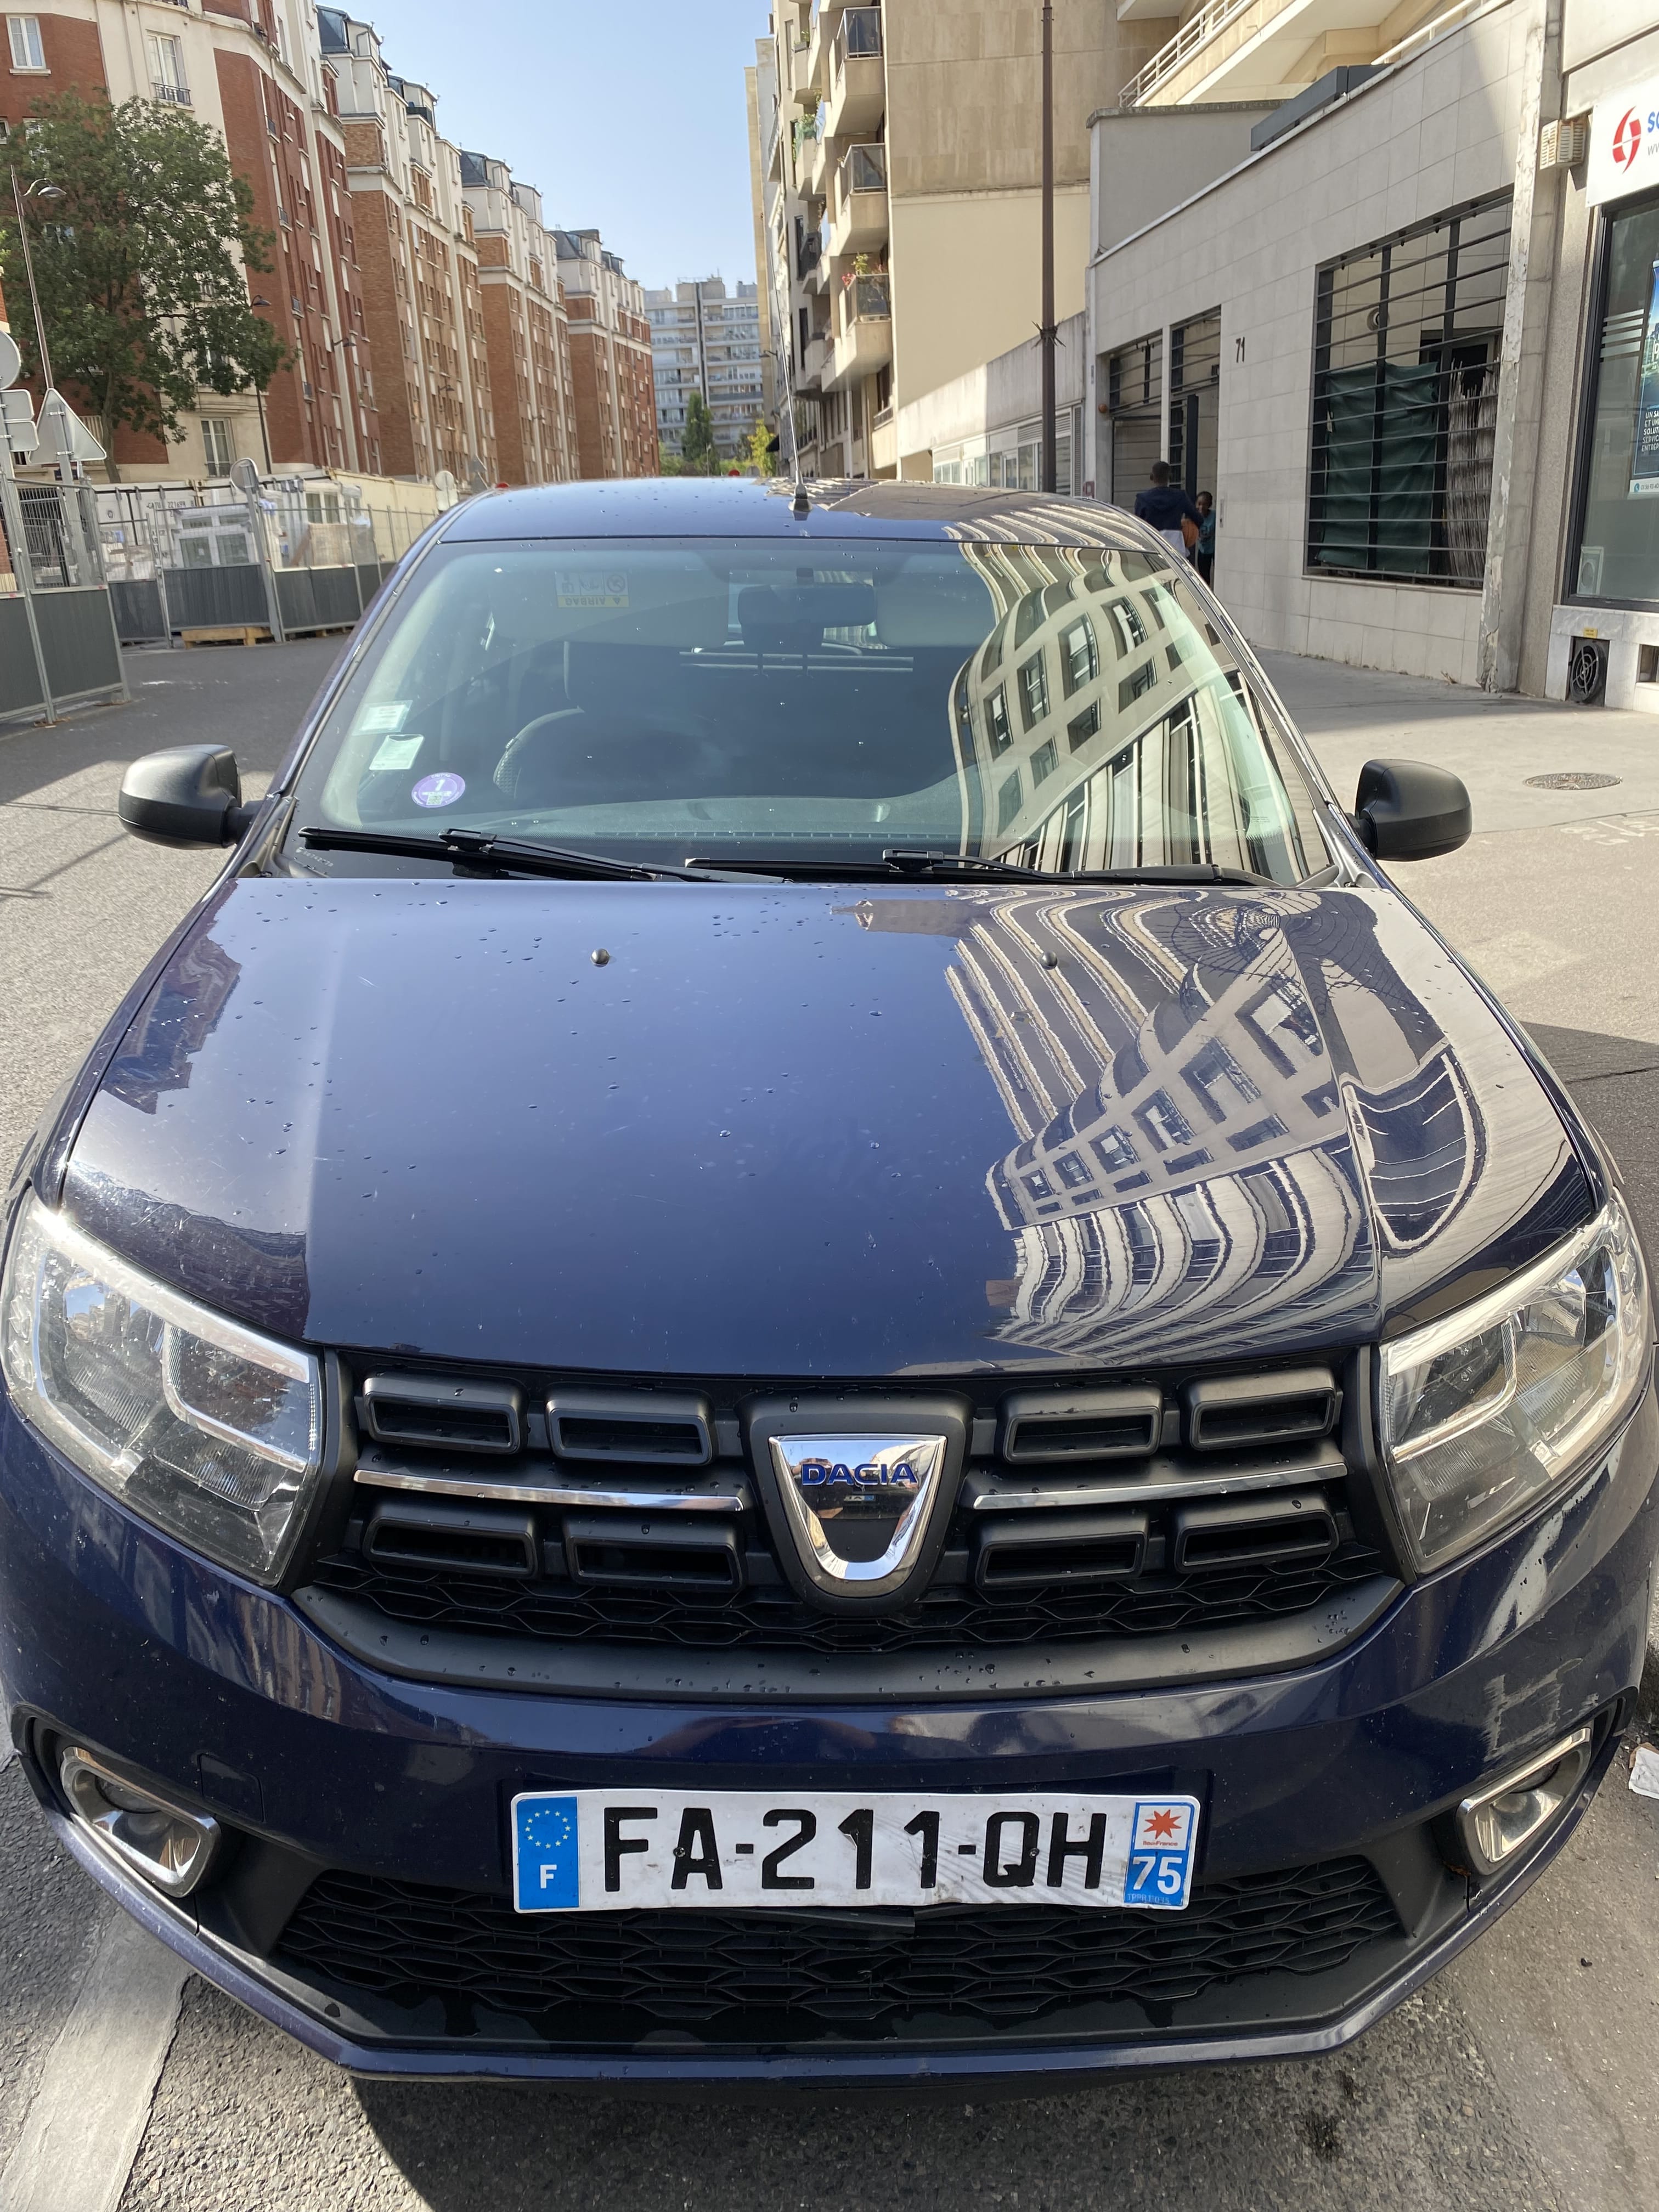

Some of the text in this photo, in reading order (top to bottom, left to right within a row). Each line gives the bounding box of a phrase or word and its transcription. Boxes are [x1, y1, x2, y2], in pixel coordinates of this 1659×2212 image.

[1235, 336, 1245, 364] 71
[565, 596, 605, 606] AIRBAG
[436, 779, 445, 791] 1
[802, 1464, 918, 1486] DACIA
[604, 1807, 1107, 1892] FA-211-QH
[540, 1864, 557, 1889] F
[1132, 1857, 1182, 1894] 75
